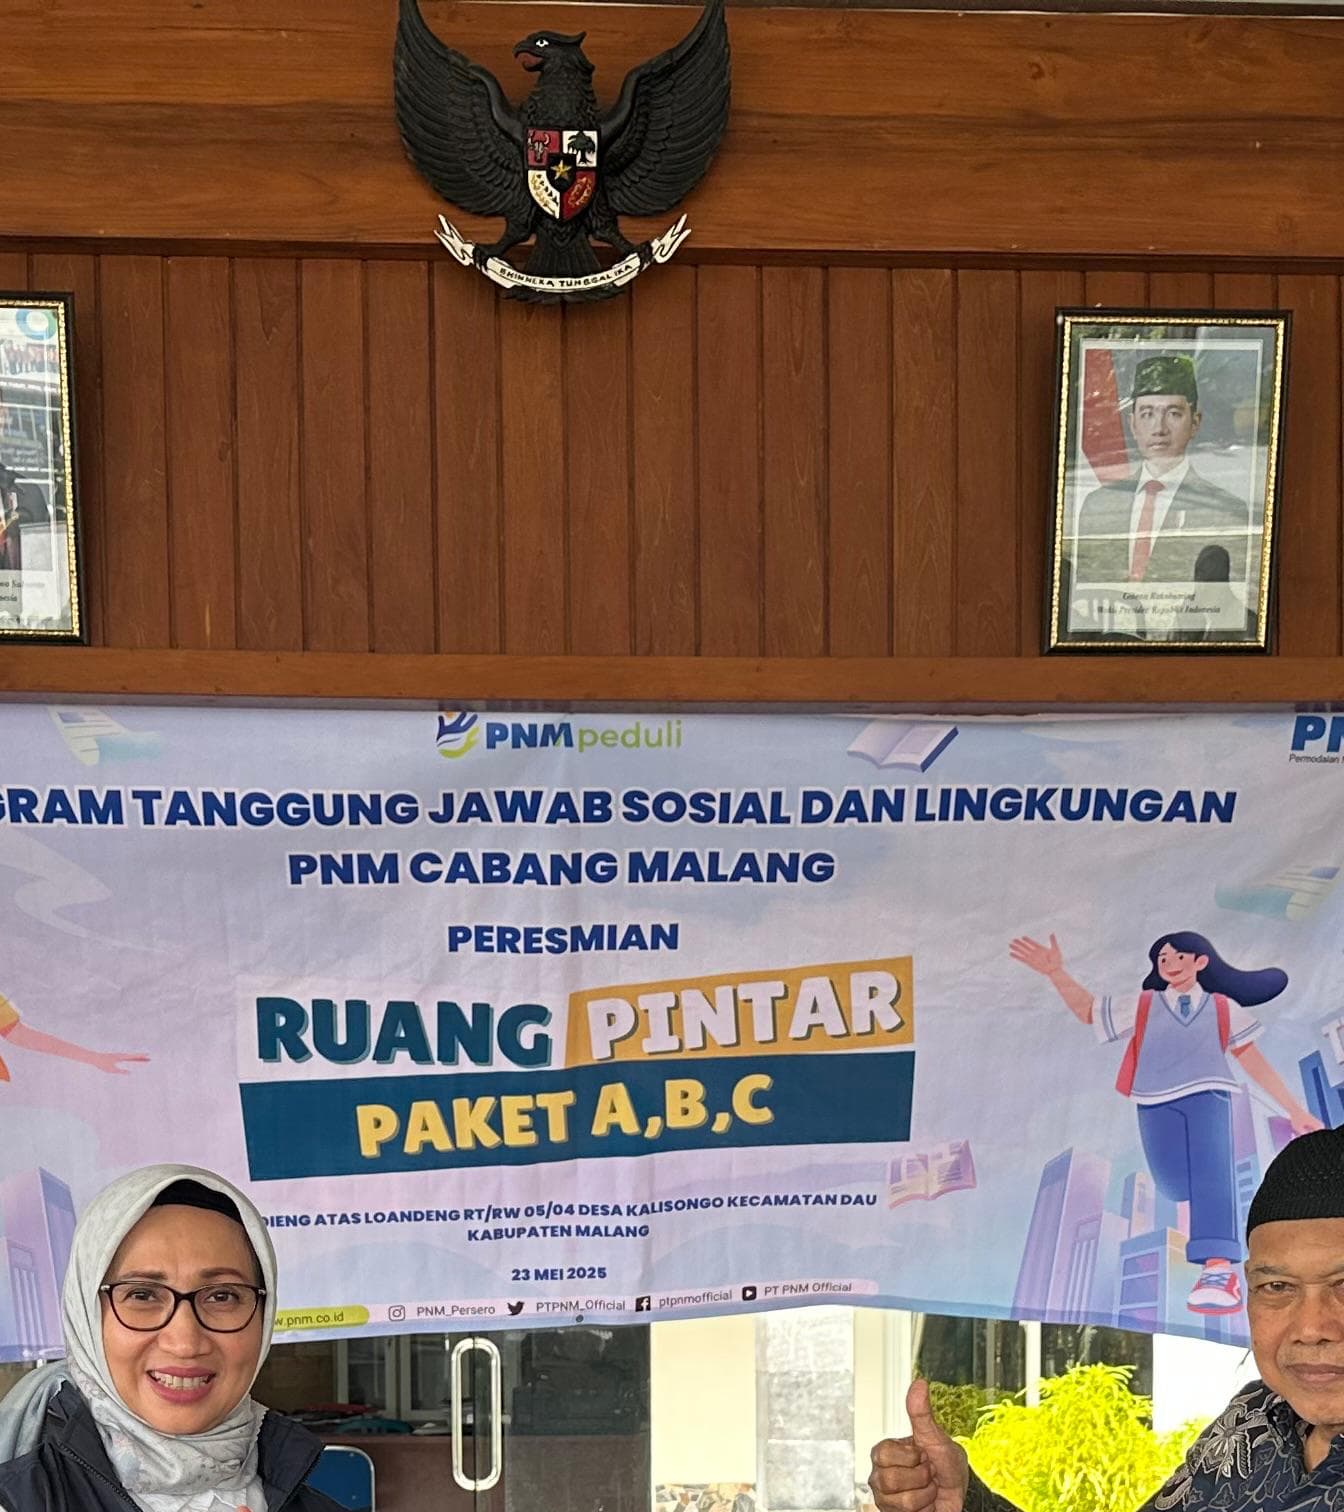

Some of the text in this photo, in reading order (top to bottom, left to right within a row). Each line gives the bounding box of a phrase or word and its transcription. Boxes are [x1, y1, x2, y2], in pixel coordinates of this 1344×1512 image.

[559, 274, 612, 287] TUNGGAL
[614, 265, 633, 277] IKA
[1289, 753, 1340, 765] Permodalan
[132, 789, 419, 827] TANGGUNG
[427, 790, 613, 824] JAWAB
[622, 789, 791, 824] SOSIAL
[801, 788, 905, 823] DAN
[914, 788, 1238, 824] LINGKUNGAN
[288, 850, 835, 886] PNM CABANG MALANG
[448, 923, 679, 955] PERESMIAN
[255, 970, 904, 1068] RUANG PINTAR
[356, 1074, 774, 1158] PAKET A,B,C
[314, 1212, 361, 1226] ATAS
[364, 1209, 460, 1225] LOANDENG
[464, 1204, 520, 1223] RT/RW
[524, 1201, 575, 1220] 05/04
[578, 1204, 622, 1217] DESA
[626, 1196, 724, 1217] KALISONGO
[727, 1194, 837, 1207] KECAMATAN
[841, 1194, 877, 1206] DAU
[468, 1224, 649, 1242] KABUPATEN MALANG
[511, 1266, 607, 1281] 23 MEI 2025
[764, 1282, 852, 1297] PT PNM Official
[536, 1300, 626, 1314] PTPNM_Official
[658, 1290, 733, 1309] ptpnmofficial
[275, 1311, 344, 1328] w.pnm.co.id
[417, 1303, 496, 1317] PNM_Persero
